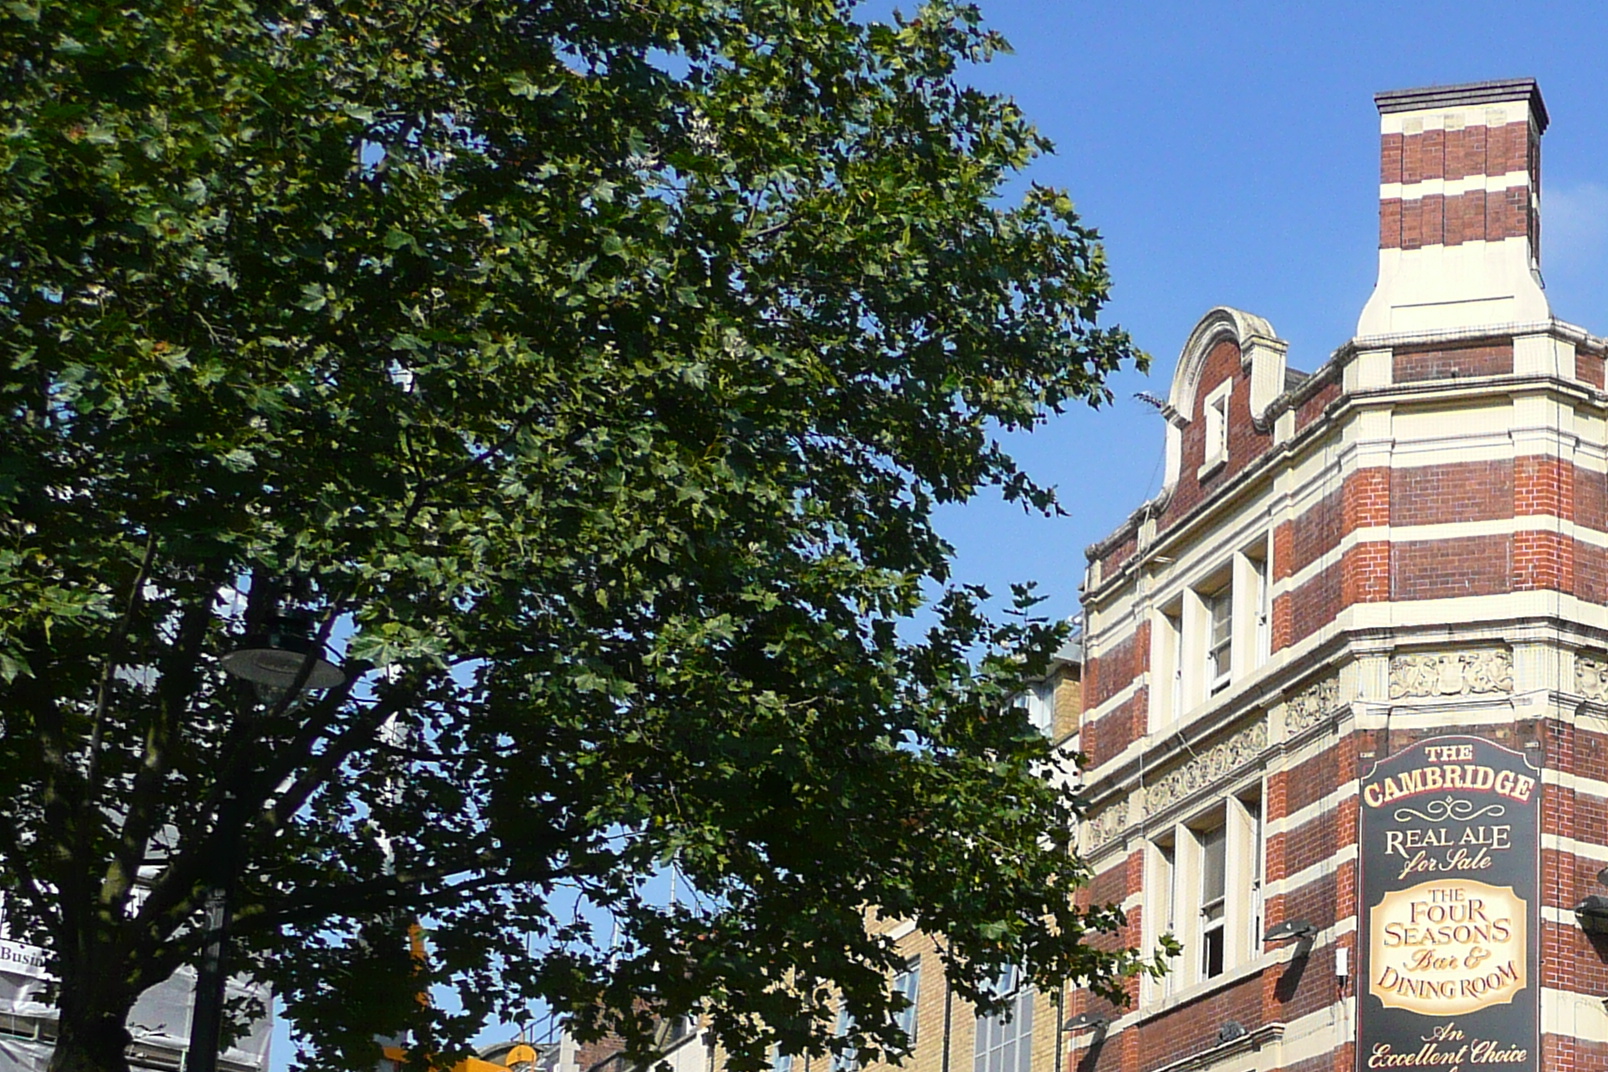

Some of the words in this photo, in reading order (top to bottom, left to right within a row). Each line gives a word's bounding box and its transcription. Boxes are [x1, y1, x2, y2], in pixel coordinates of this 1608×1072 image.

[1424, 744, 1473, 762] THE
[1363, 764, 1535, 807] CAMBRIDGE
[1384, 829, 1454, 859] REAL
[1460, 825, 1511, 849] ALE
[1398, 850, 1438, 880] for
[1438, 847, 1493, 872] Sale
[1427, 888, 1466, 903] THE
[1410, 899, 1490, 924] FOUR
[1383, 917, 1511, 948] SEASONS
[1402, 948, 1458, 972] Bar
[1463, 946, 1491, 970] &
[1376, 965, 1458, 999] DINING
[1459, 960, 1519, 1000] ROOM
[1420, 1021, 1465, 1042] An
[1367, 1042, 1469, 1069] Excellent
[1470, 1038, 1528, 1065] Choice
